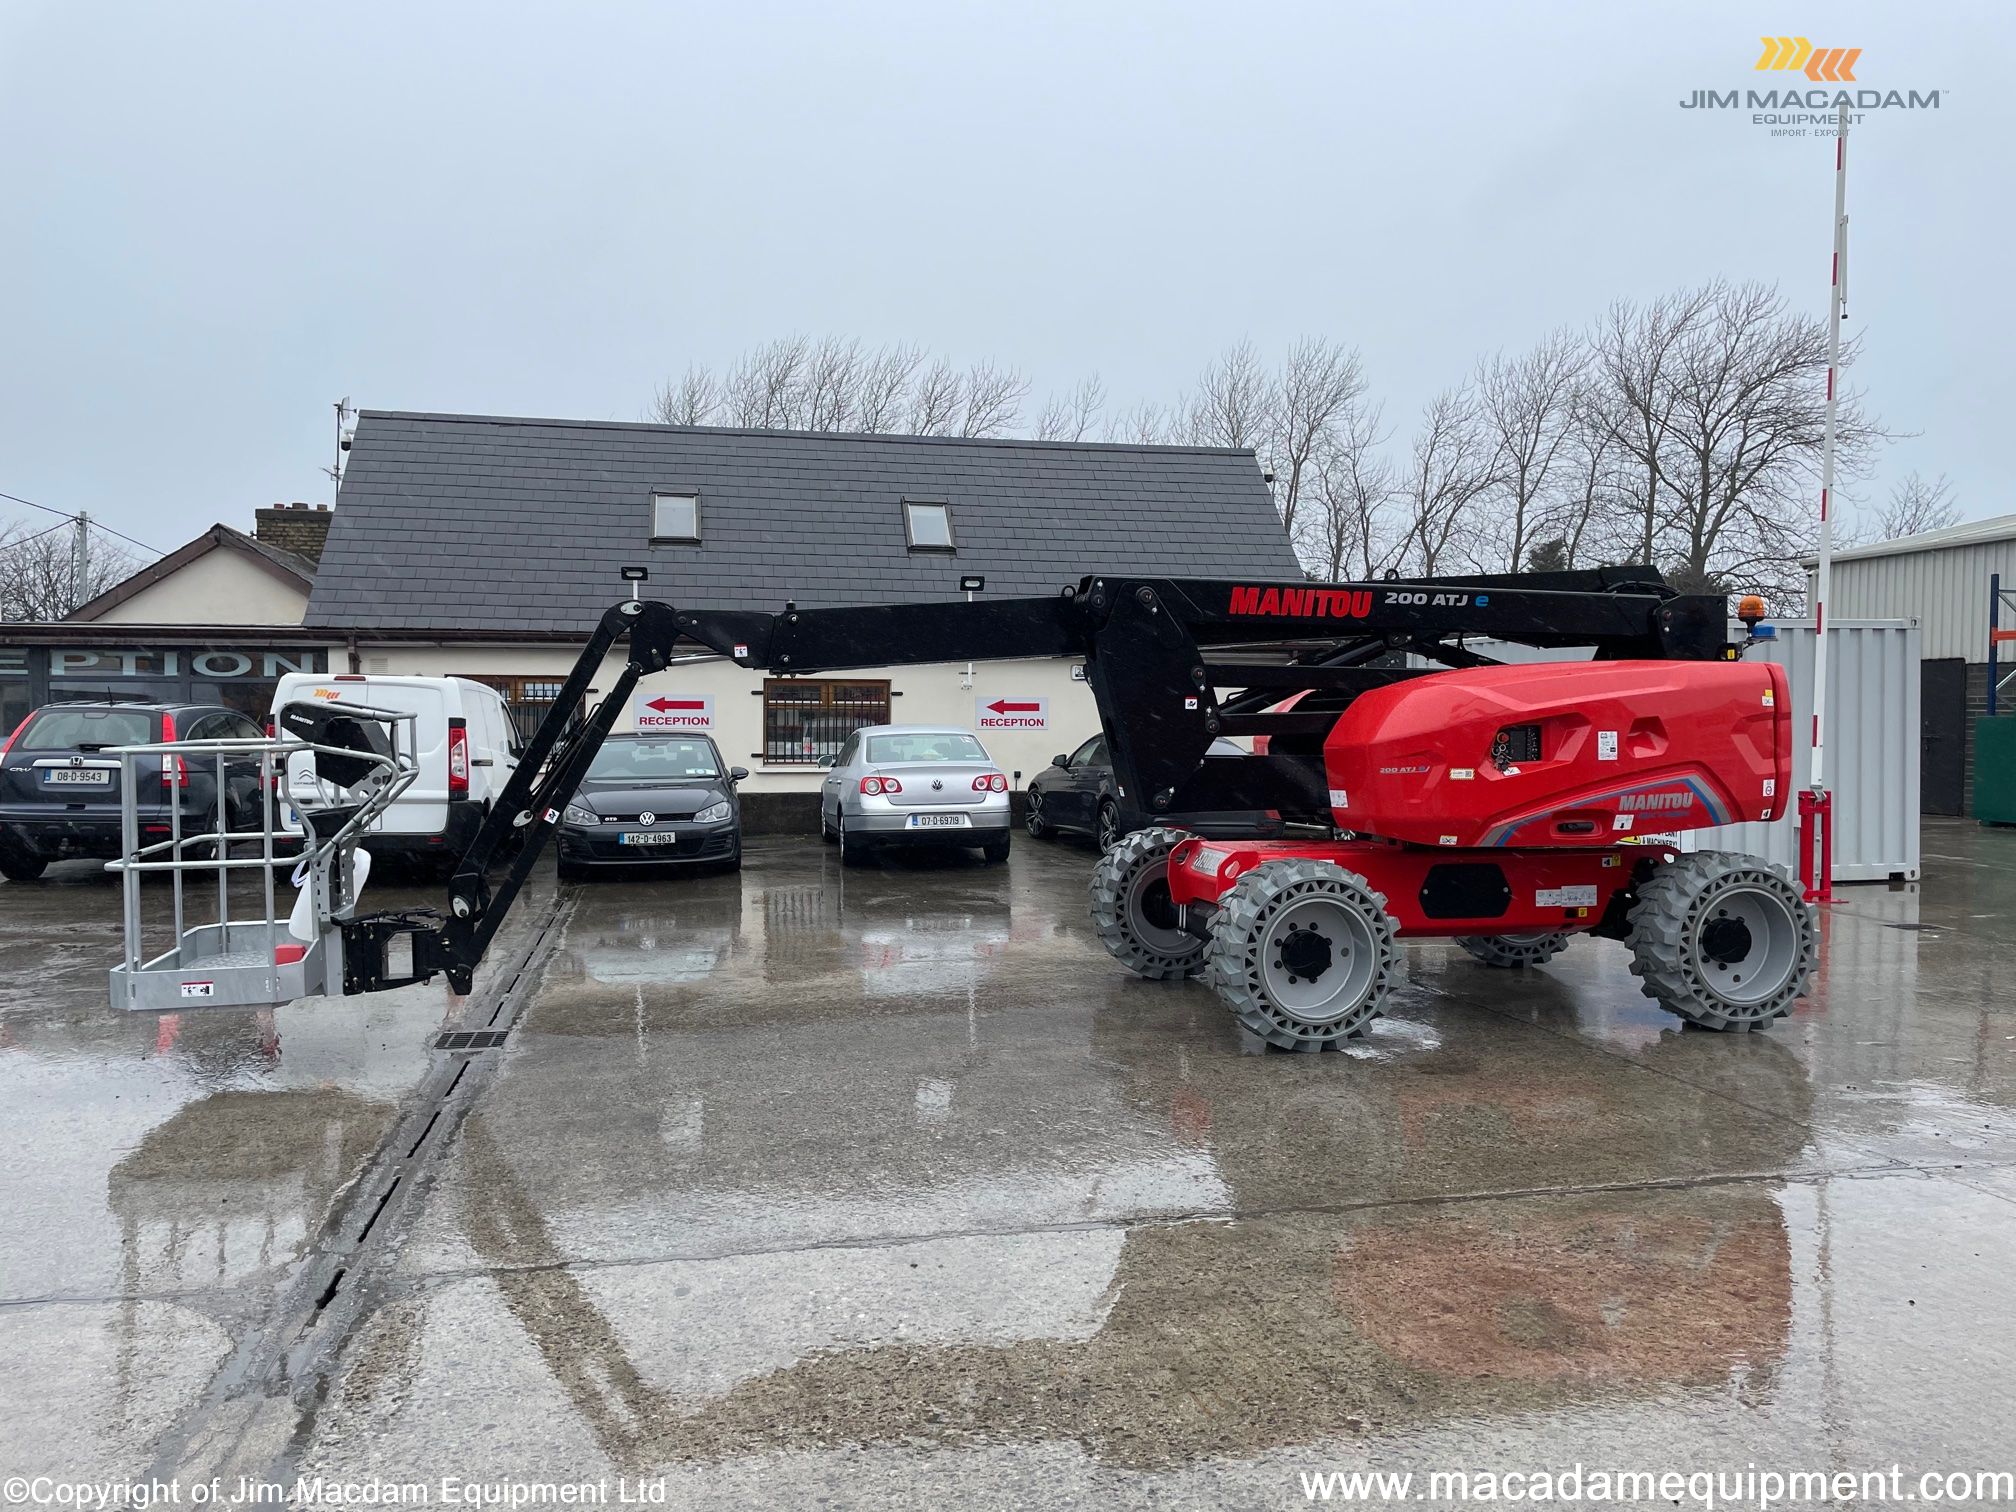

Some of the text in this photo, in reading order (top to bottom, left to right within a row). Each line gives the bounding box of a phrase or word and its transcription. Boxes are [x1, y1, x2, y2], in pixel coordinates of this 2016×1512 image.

[1229, 587, 1373, 618] MANITOU
[1385, 592, 1427, 605] 200
[1431, 594, 1469, 606] ATJ
[639, 717, 710, 725] RECEPTION
[981, 718, 1045, 727] RECEPTION
[57, 772, 102, 781] 08-D-9543
[1619, 792, 1694, 811] MANITOU
[921, 816, 960, 826] 07-D-69719
[627, 834, 672, 843] 142-D-4963
